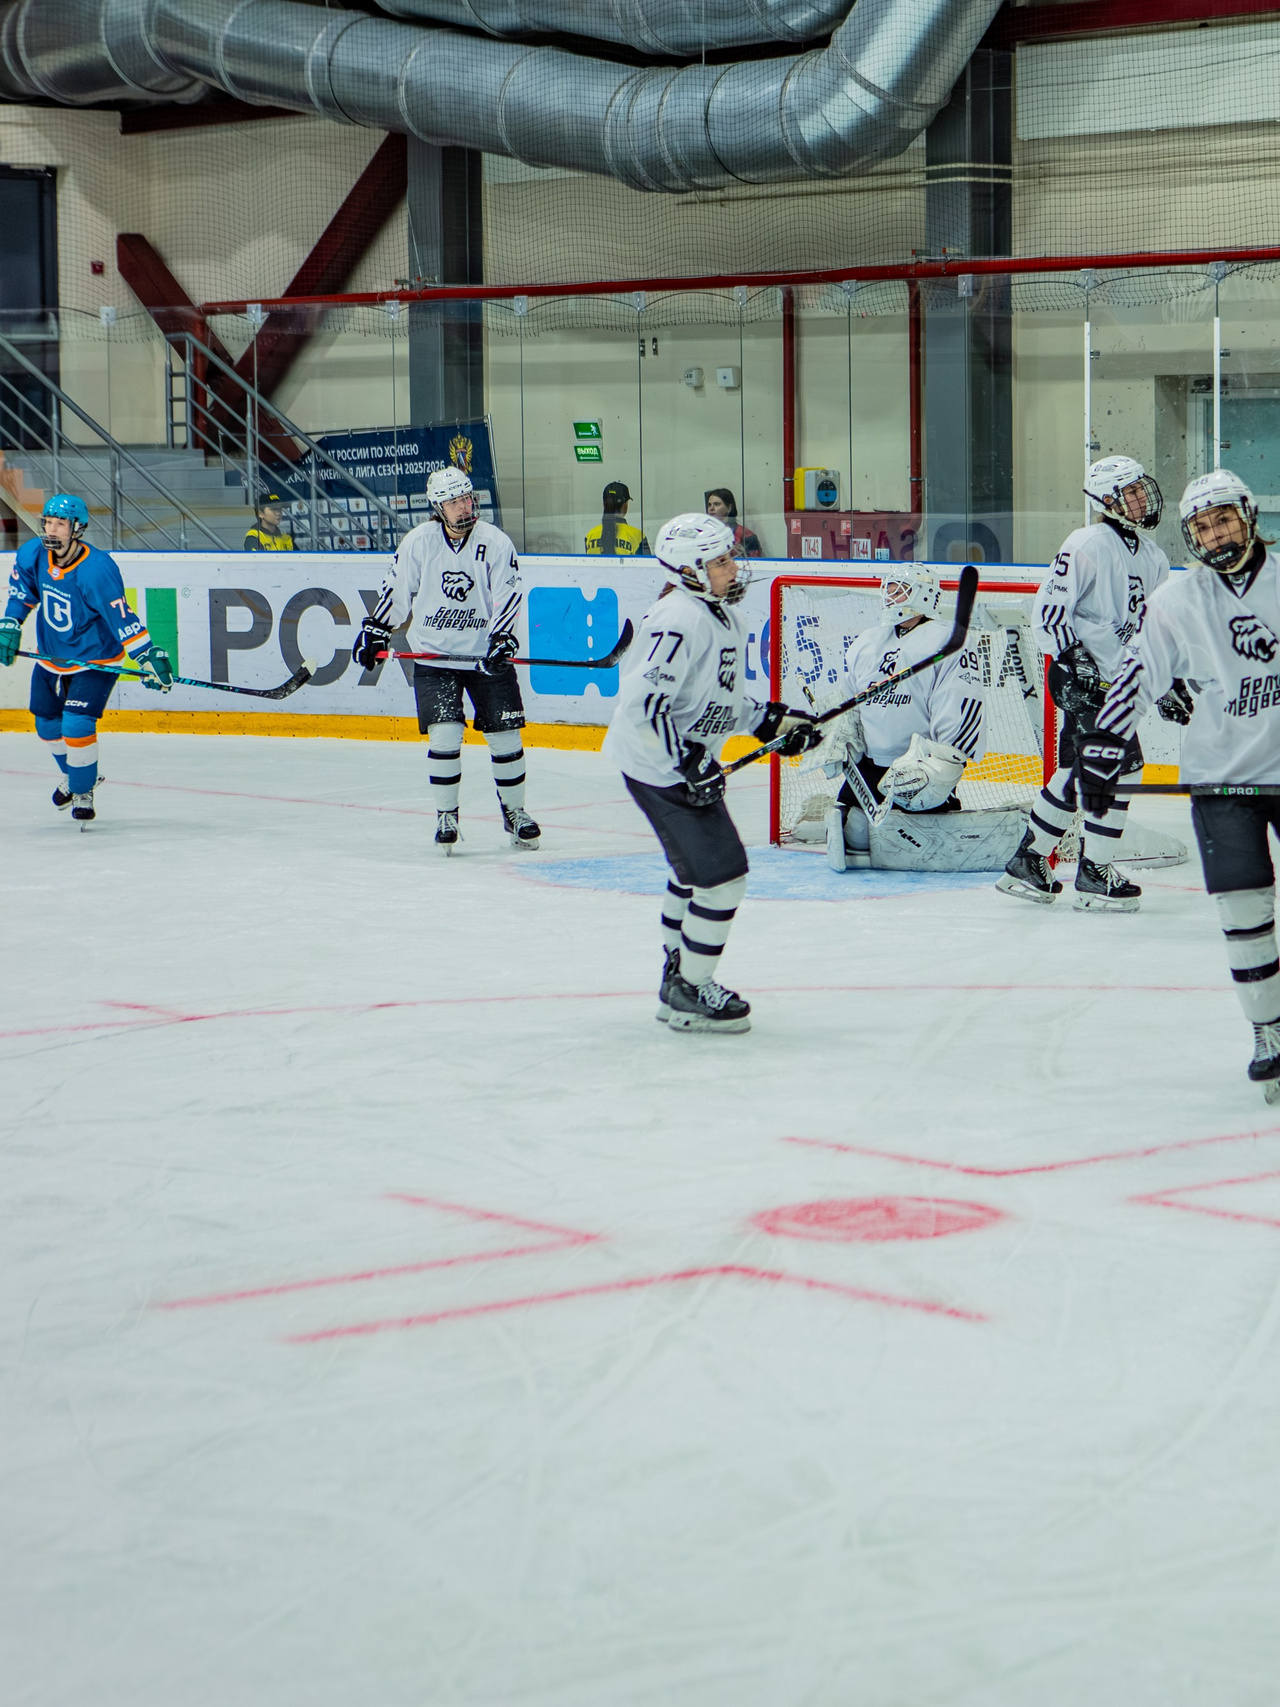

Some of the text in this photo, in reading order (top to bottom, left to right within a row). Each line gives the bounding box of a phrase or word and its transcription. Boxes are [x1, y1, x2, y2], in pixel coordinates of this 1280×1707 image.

[337, 447, 369, 461] РОССИИ
[371, 446, 383, 458] ПО
[576, 447, 599, 456] ВЫХОД
[355, 465, 377, 478] ЛИГА
[404, 460, 446, 475] 2025/2026
[363, 624, 392, 639] CCM
[647, 631, 684, 664] 77
[65, 700, 89, 708] CCM
